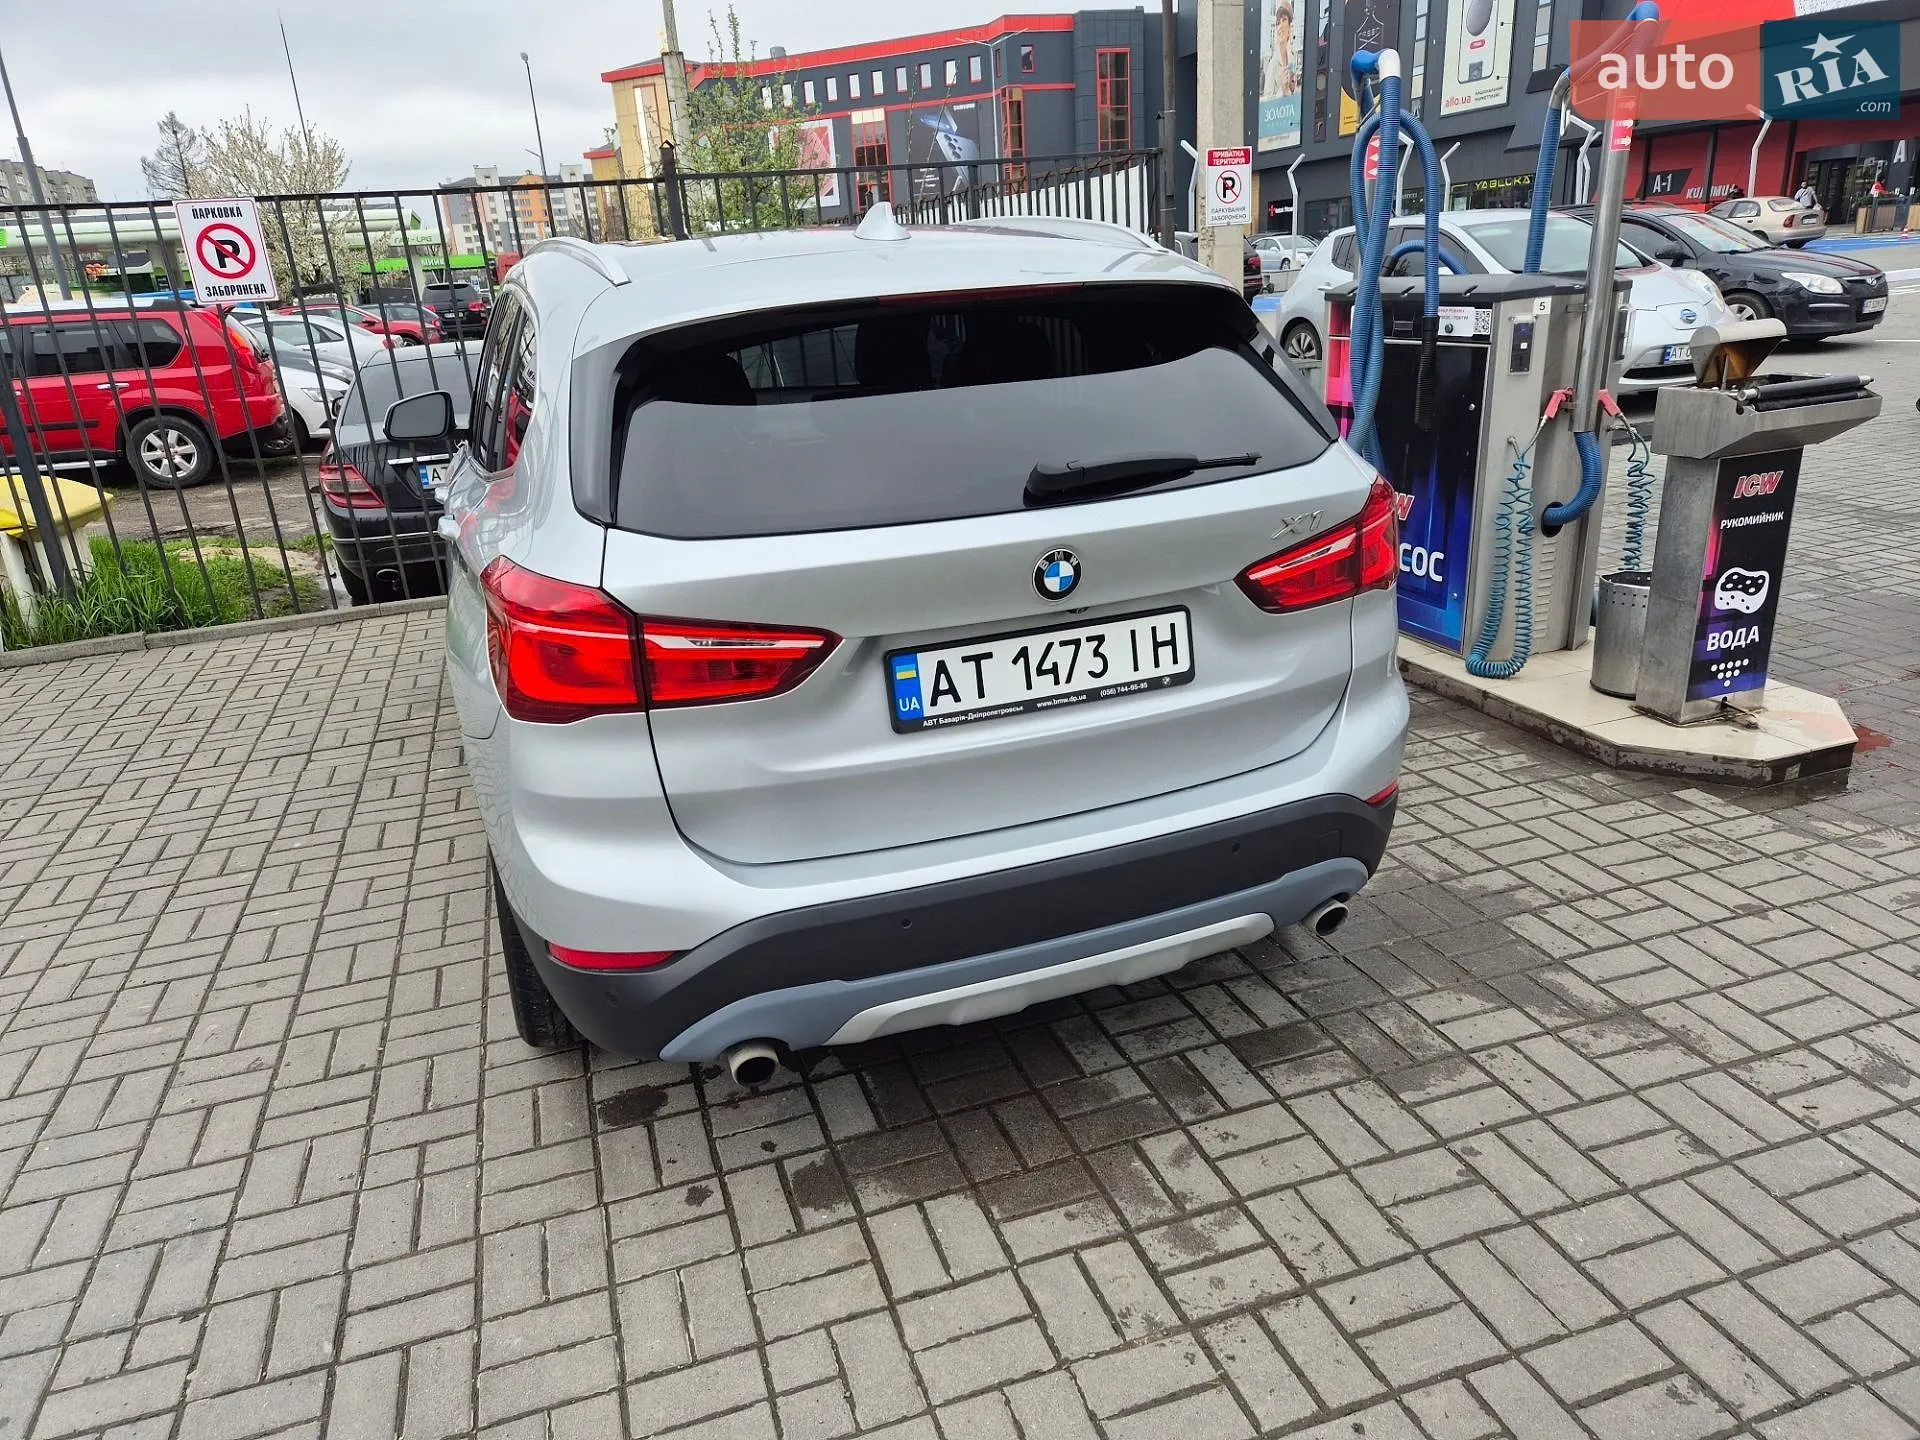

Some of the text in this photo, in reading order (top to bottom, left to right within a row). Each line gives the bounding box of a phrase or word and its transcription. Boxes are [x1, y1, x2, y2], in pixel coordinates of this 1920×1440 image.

[1445, 96, 1472, 108] allo.ua
[1264, 103, 1295, 122] ЗОЛОТА
[1213, 150, 1245, 158] ПРИВАТНА
[1475, 175, 1530, 191] YABLUKA
[191, 206, 243, 219] ПАРКОВКА
[205, 283, 267, 297] ЗАБОРОНЕНА
[1539, 302, 1546, 311] 5
[1733, 470, 1785, 499] ICW
[1720, 511, 1785, 530] РУКОМИЙНИК
[1039, 550, 1079, 570] BMW
[1399, 542, 1445, 582] СОС
[1706, 625, 1760, 652] ВОДА
[930, 622, 1179, 707] AT 1473 IH
[899, 697, 920, 713] UA
[1036, 693, 1087, 709] www.bmw.dp.ua
